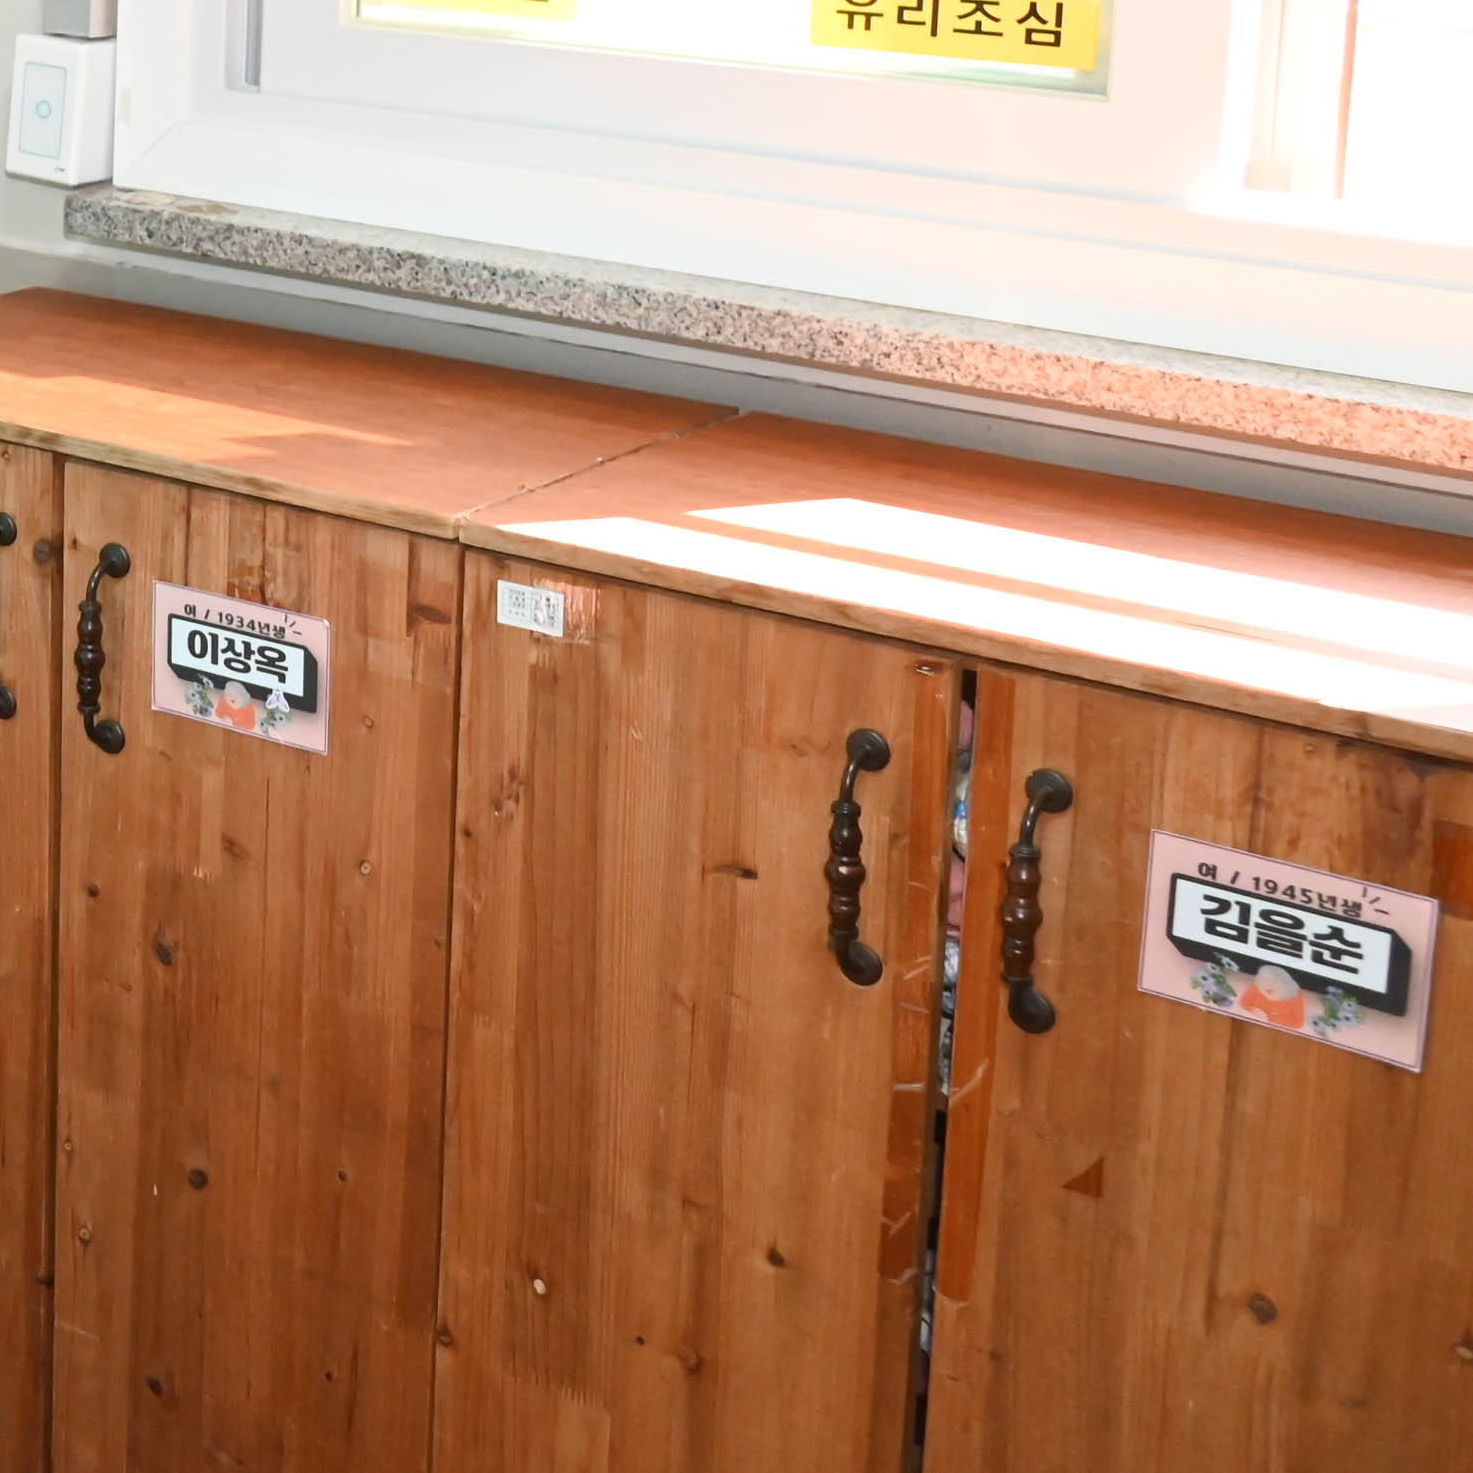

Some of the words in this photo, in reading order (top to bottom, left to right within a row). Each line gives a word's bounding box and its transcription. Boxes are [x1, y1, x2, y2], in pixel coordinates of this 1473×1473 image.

[184, 604, 197, 617] 여
[217, 612, 286, 639] 1934년생
[187, 629, 289, 684] 이상옥
[1198, 862, 1217, 880] 여
[1251, 876, 1363, 917] 1945년생
[1200, 893, 1364, 975] 김을순
